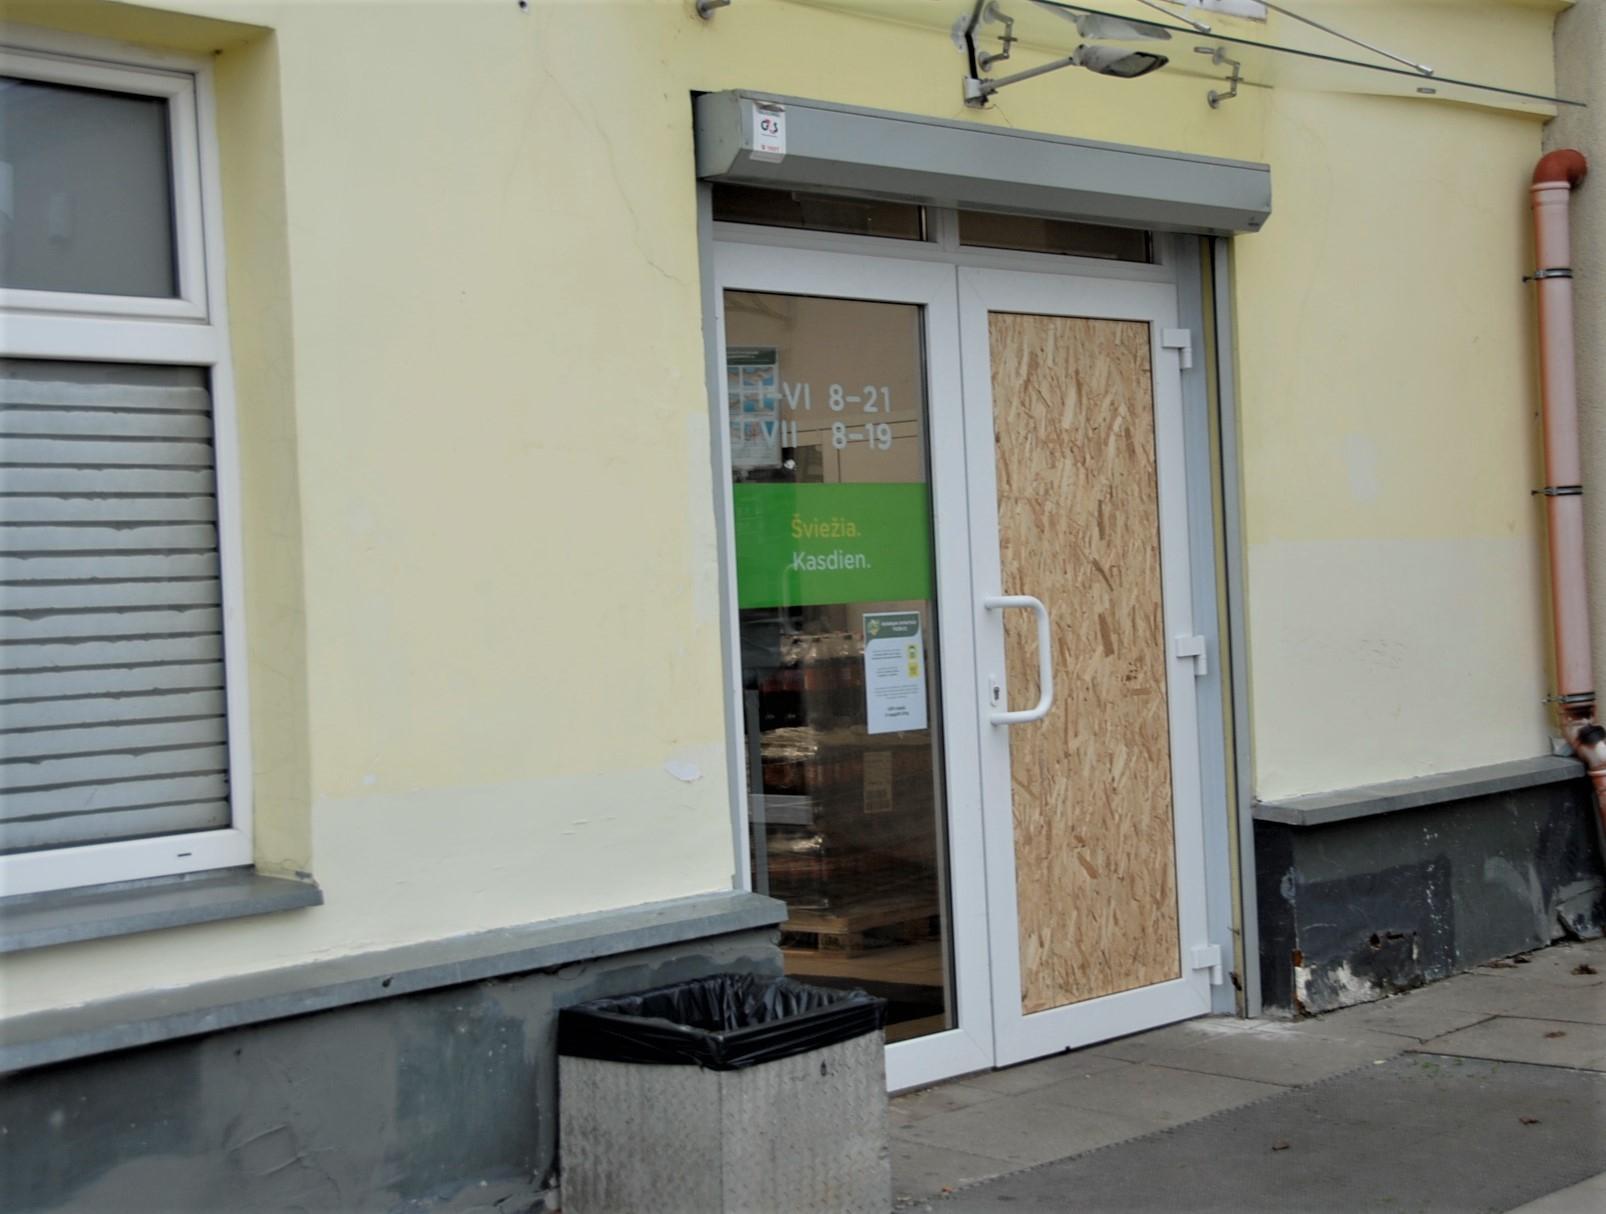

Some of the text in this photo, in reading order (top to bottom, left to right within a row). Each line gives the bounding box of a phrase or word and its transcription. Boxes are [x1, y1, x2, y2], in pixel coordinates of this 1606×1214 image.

[828, 383, 891, 413] 8-21
[761, 420, 893, 451] VII 8-19
[791, 513, 862, 538] Šviežia.
[792, 549, 872, 571] Kasdien.
